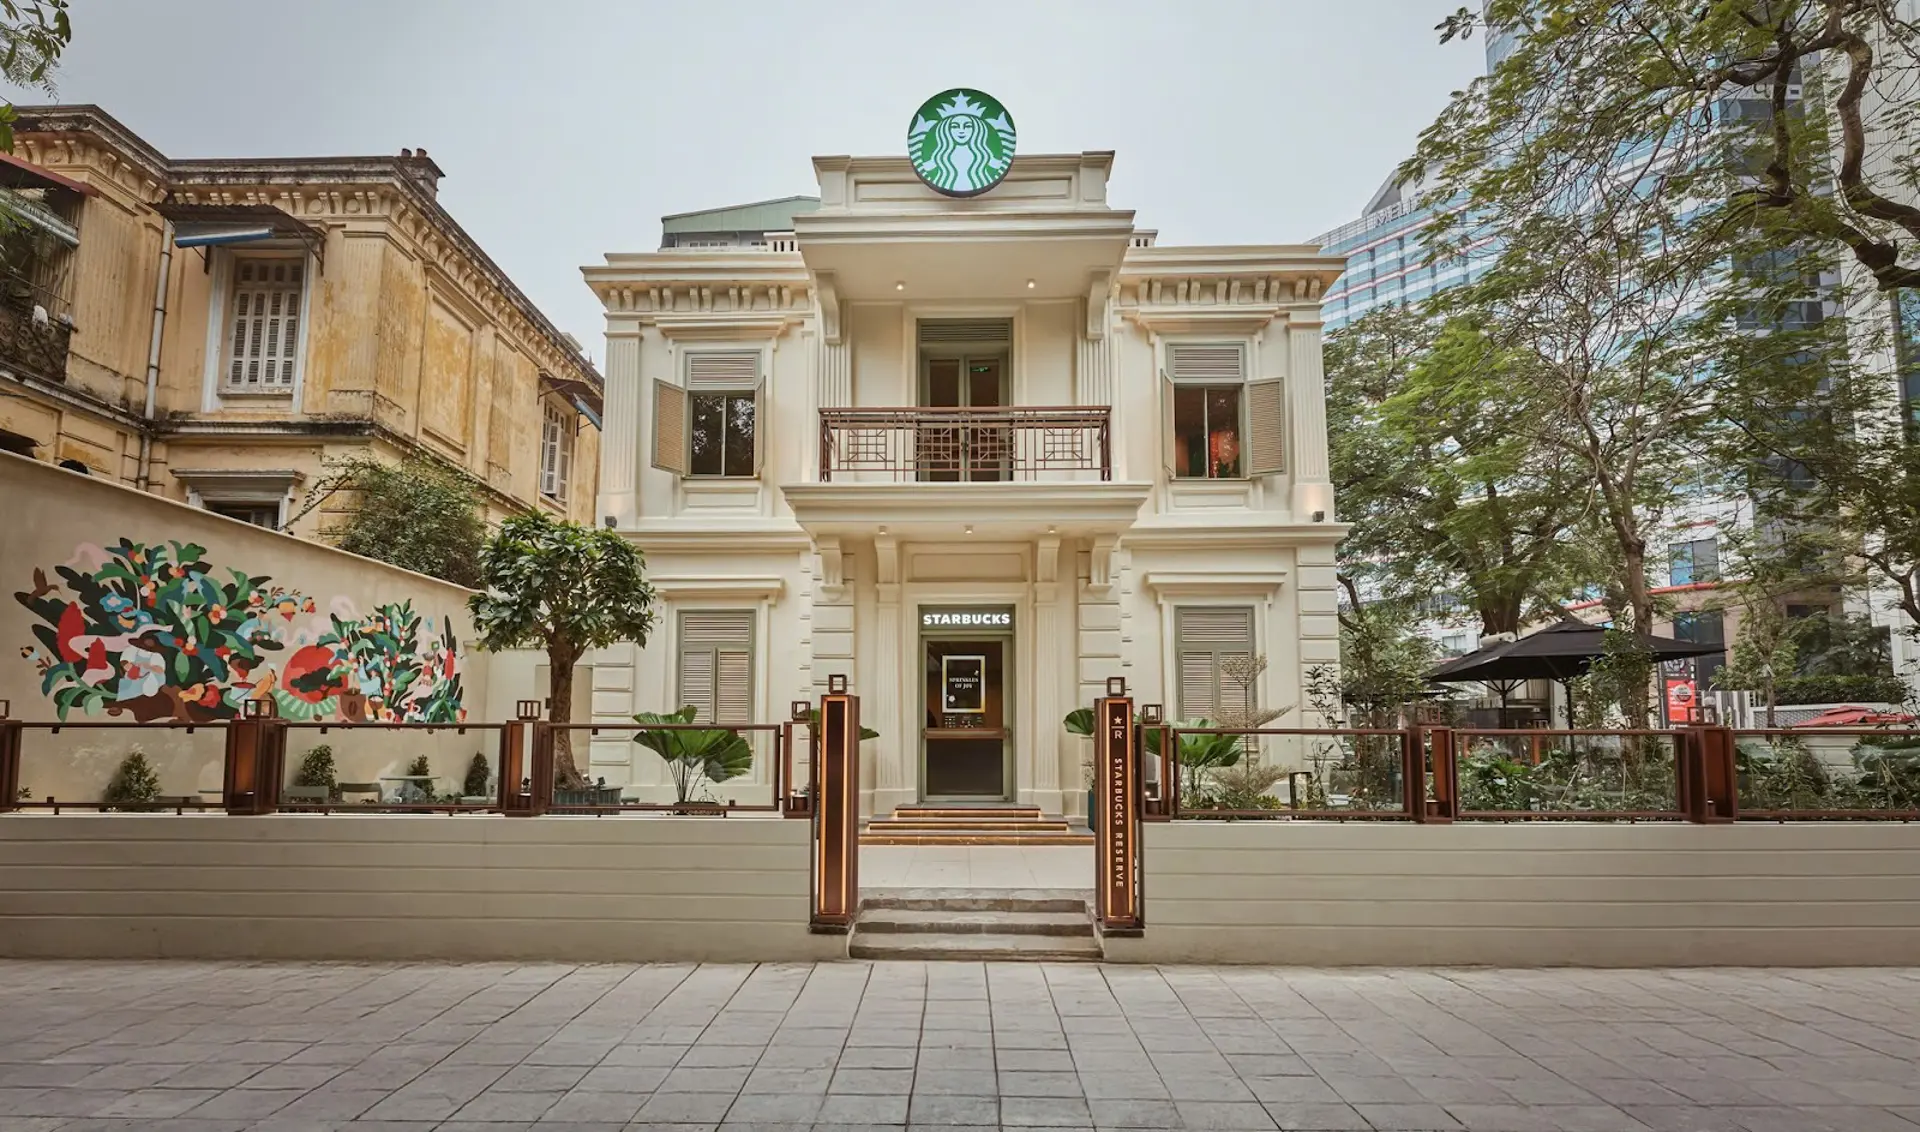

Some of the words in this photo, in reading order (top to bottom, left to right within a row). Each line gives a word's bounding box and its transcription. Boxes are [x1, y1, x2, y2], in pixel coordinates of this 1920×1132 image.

[923, 613, 1010, 625] STARBUCKS
[1114, 730, 1123, 739] R
[1114, 758, 1123, 826] STARBUCKS
[1115, 833, 1124, 888] RESERVE
